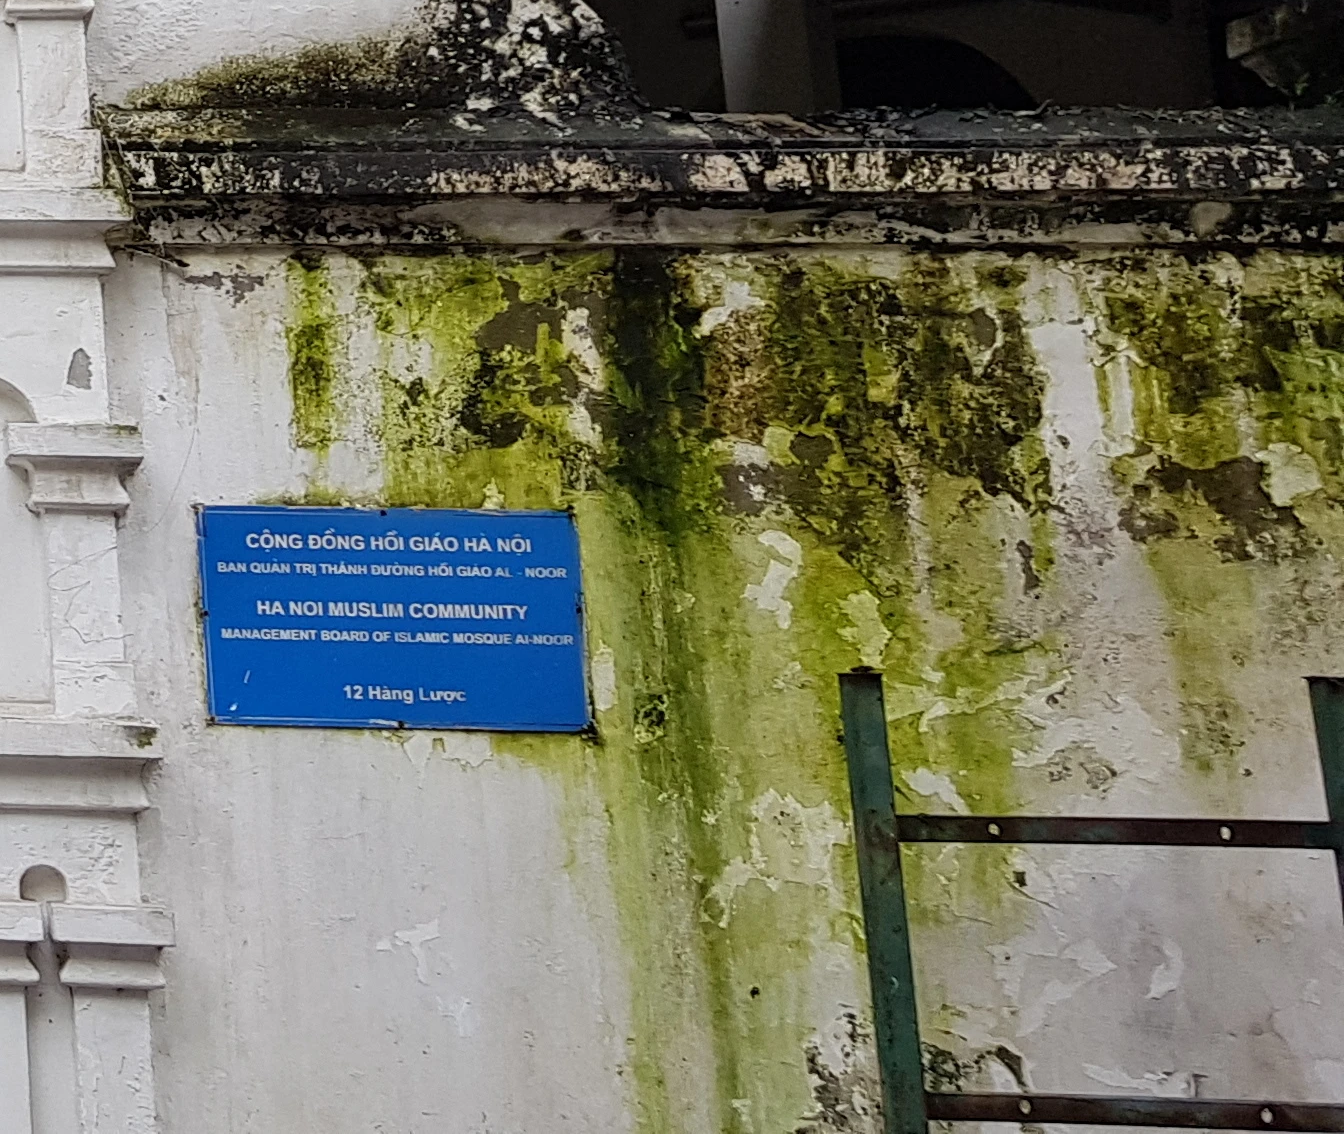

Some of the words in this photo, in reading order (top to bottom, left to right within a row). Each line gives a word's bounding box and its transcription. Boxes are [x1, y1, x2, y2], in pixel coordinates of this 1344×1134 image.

[245, 528, 303, 553] CỘNG
[307, 527, 366, 551] ĐỒNG
[408, 531, 460, 552] GIÁO
[463, 531, 493, 553] HÀ
[496, 533, 533, 556] NỘI
[216, 561, 247, 573] BAN
[293, 562, 318, 577] TRỊ
[524, 567, 568, 579] NOOR
[256, 599, 285, 616] HA
[289, 600, 324, 617] NOI
[328, 601, 404, 618] MUSLIM
[408, 602, 528, 620] COMMUNITY
[220, 627, 319, 640] MANAGEMENT
[320, 629, 369, 642] BOARD
[372, 630, 391, 643] OF
[394, 631, 450, 643] ISLAMIC
[452, 632, 512, 645] MOSQUE
[342, 684, 364, 700] 12
[367, 685, 414, 705] Hàng
[418, 687, 467, 705] Lược
